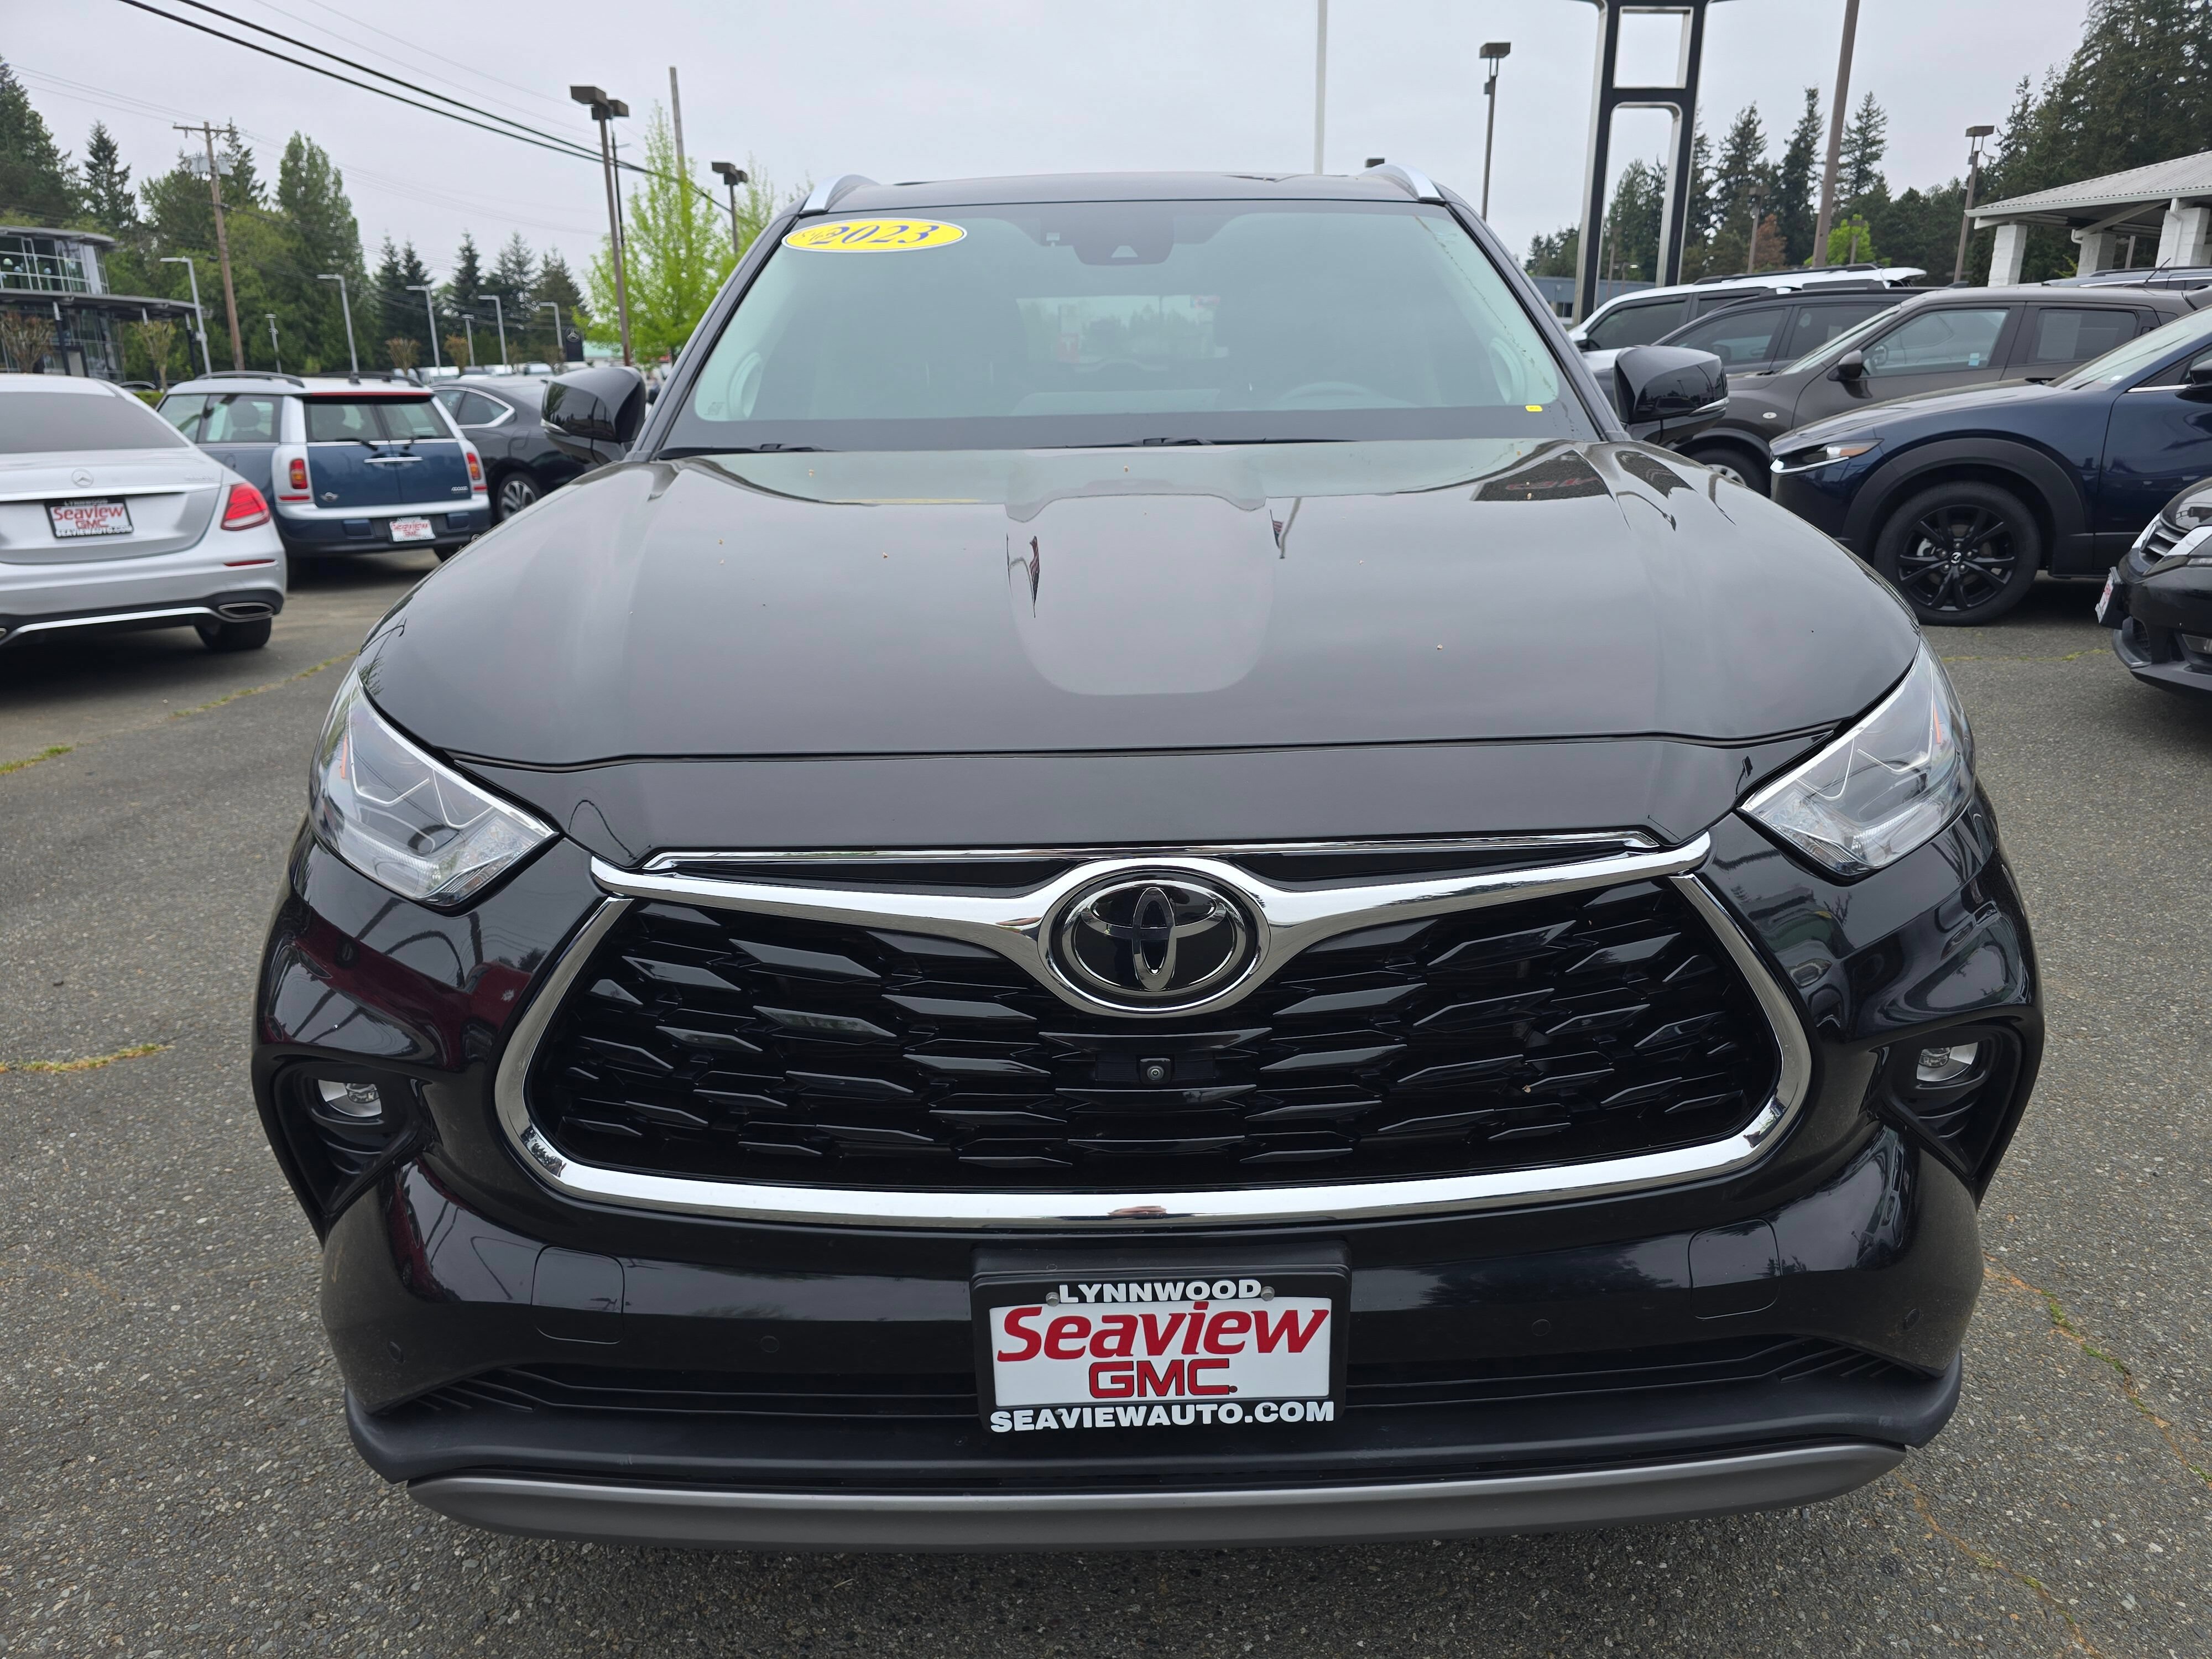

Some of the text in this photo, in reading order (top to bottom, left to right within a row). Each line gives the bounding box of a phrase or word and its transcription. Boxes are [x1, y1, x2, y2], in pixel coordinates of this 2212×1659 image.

[808, 225, 940, 245] 2023
[53, 504, 124, 521] Seaview
[75, 519, 109, 529] GMC
[1058, 1279, 1261, 1303] LYNNWOOD
[997, 1301, 1330, 1362] Seaview
[1088, 1358, 1230, 1399] GMC
[990, 1401, 1334, 1433] SEAVIEWAUTO.COM
